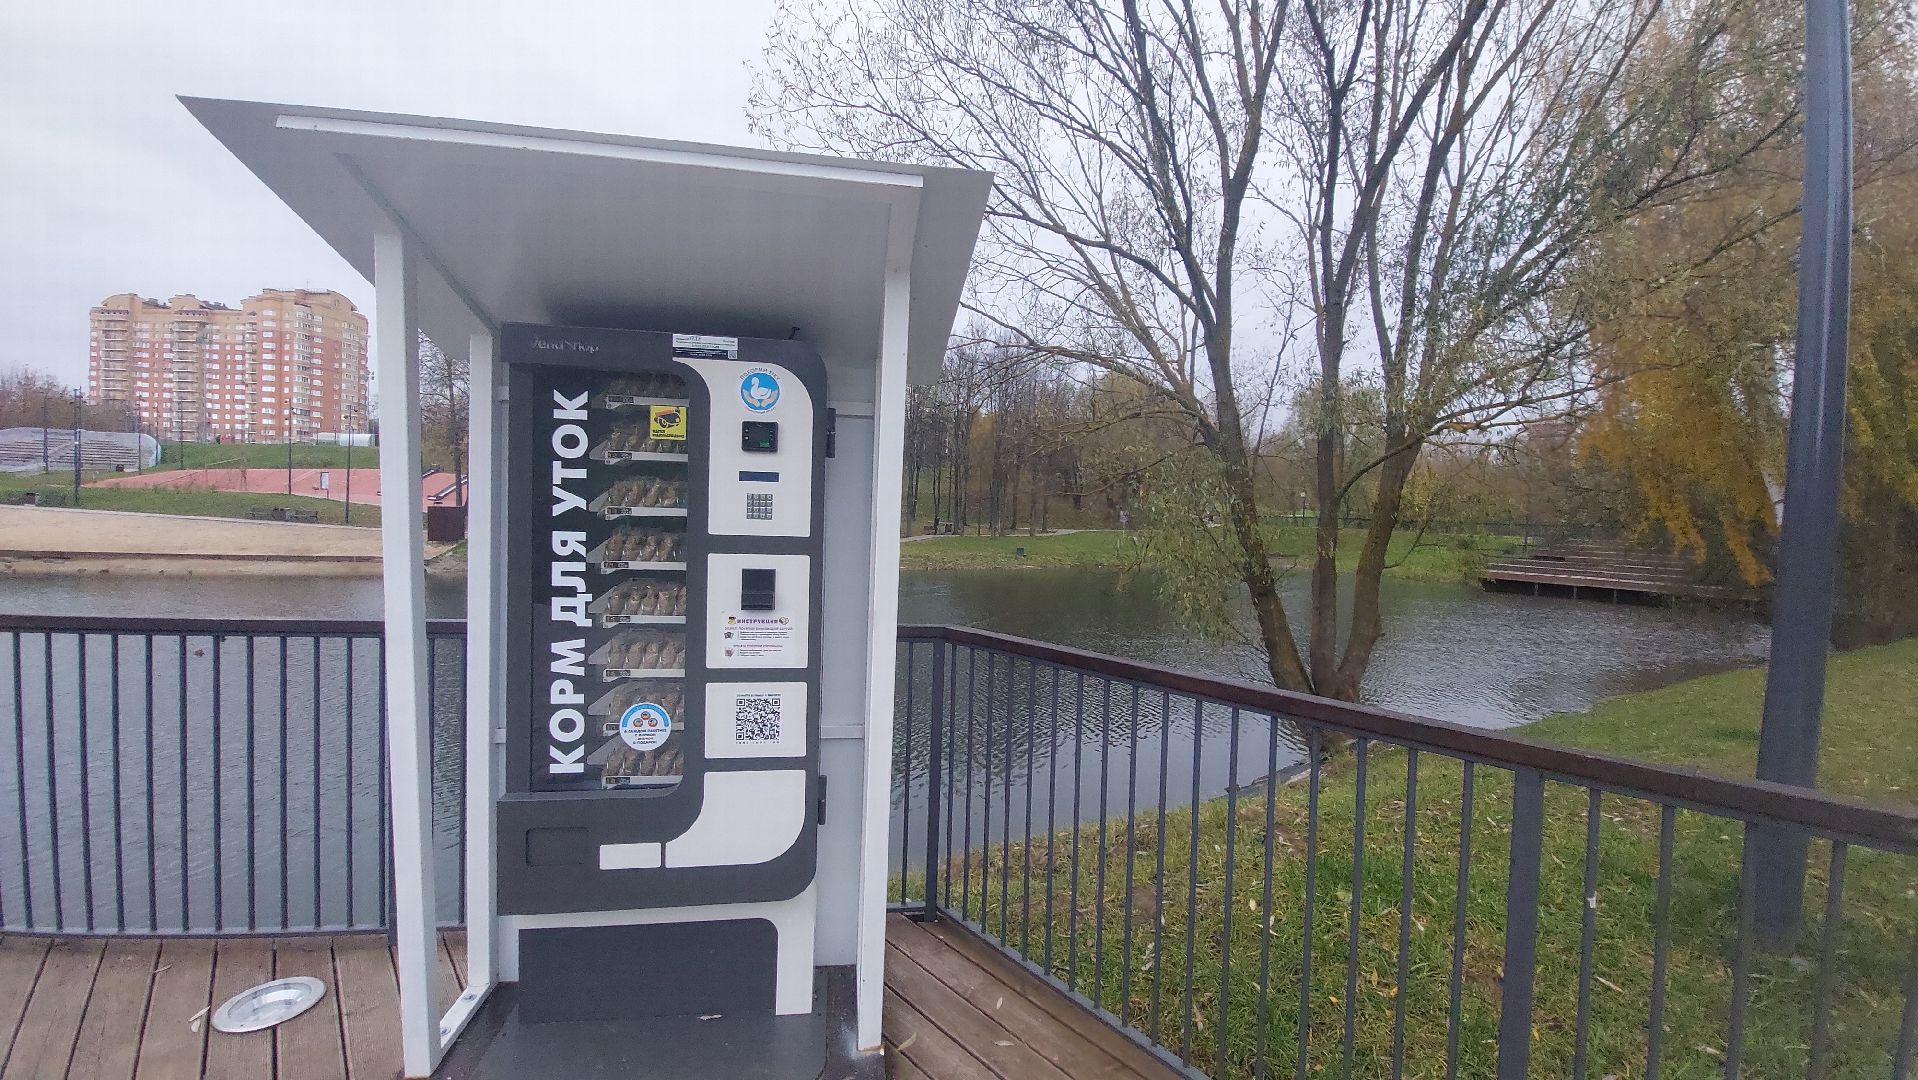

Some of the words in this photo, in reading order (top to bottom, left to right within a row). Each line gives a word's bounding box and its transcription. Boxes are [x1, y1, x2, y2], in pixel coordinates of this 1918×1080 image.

[552, 388, 589, 517] УТОК
[551, 530, 593, 627] ДЛЯ
[549, 638, 586, 774] КОРМ
